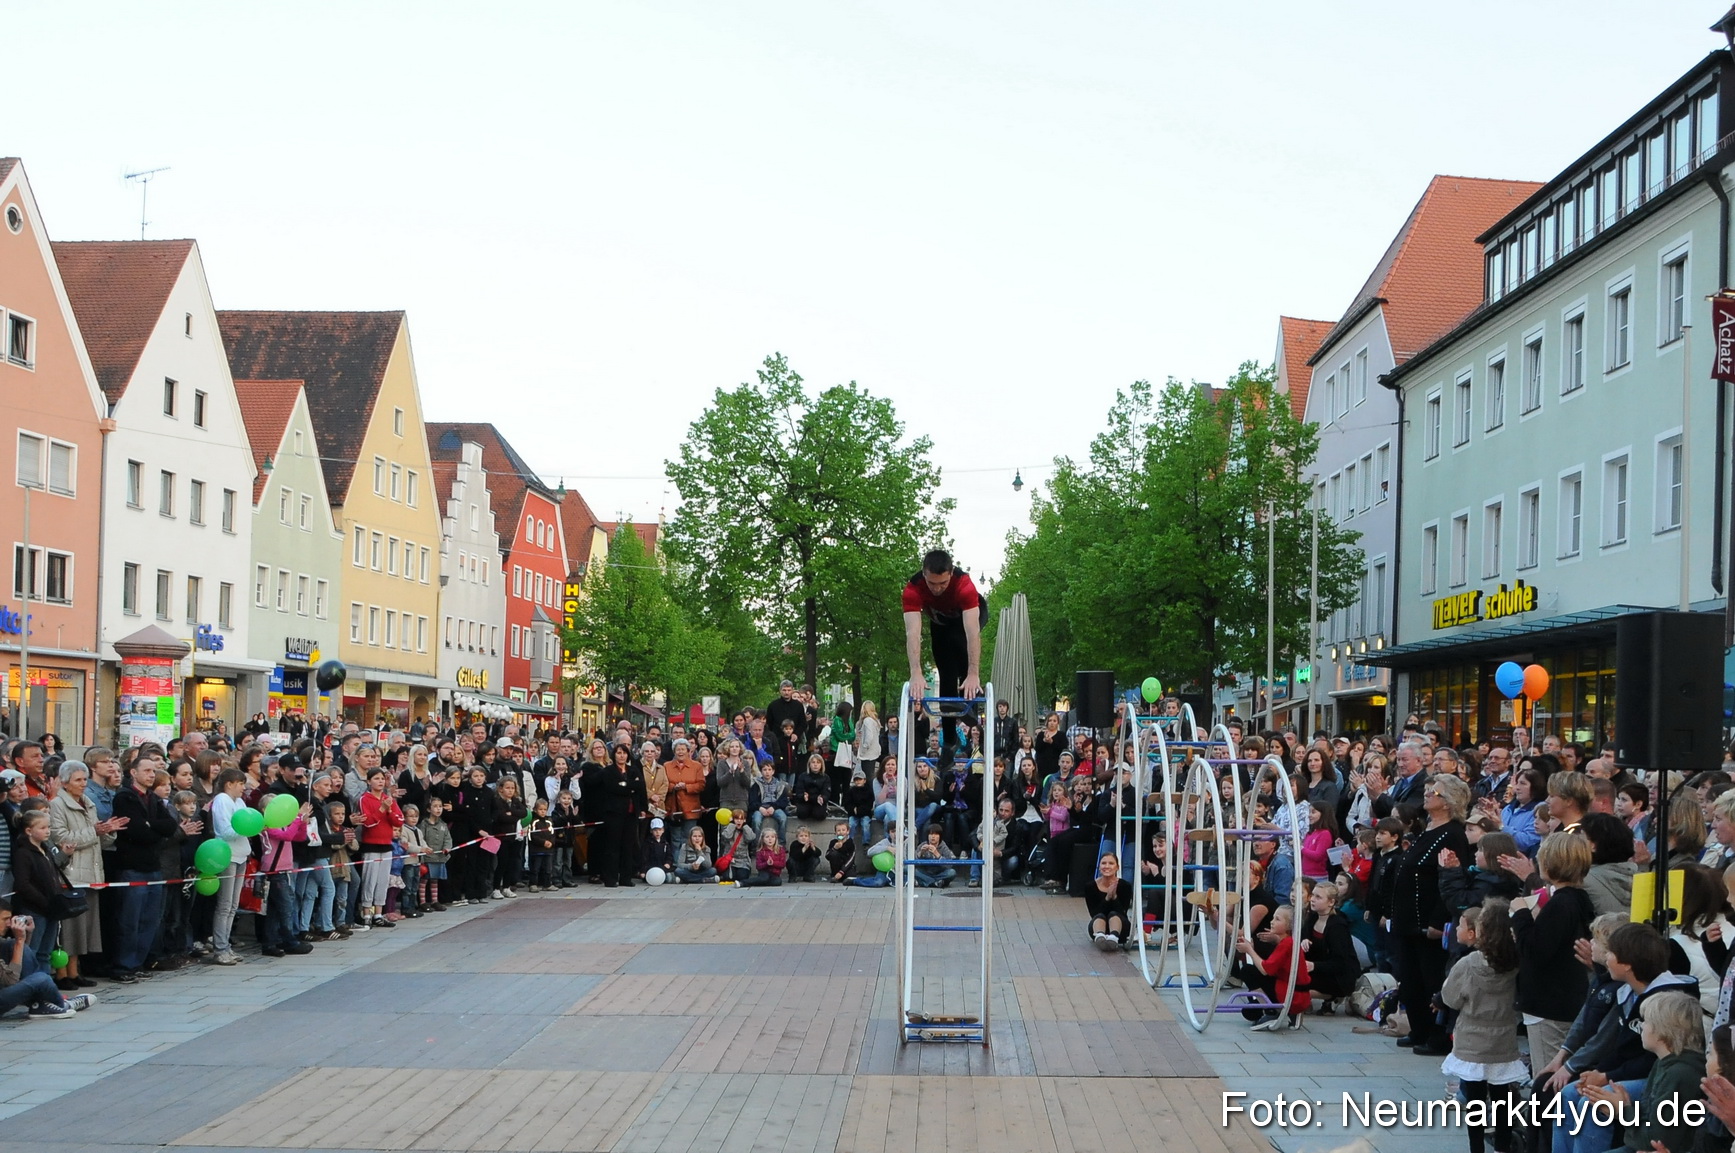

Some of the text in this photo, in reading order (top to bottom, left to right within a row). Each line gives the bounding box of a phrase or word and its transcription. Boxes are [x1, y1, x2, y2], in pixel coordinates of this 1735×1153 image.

[1719, 309, 1735, 374] Achatz
[563, 584, 579, 662] HOTL
[1433, 579, 1535, 629] mayer schuhe
